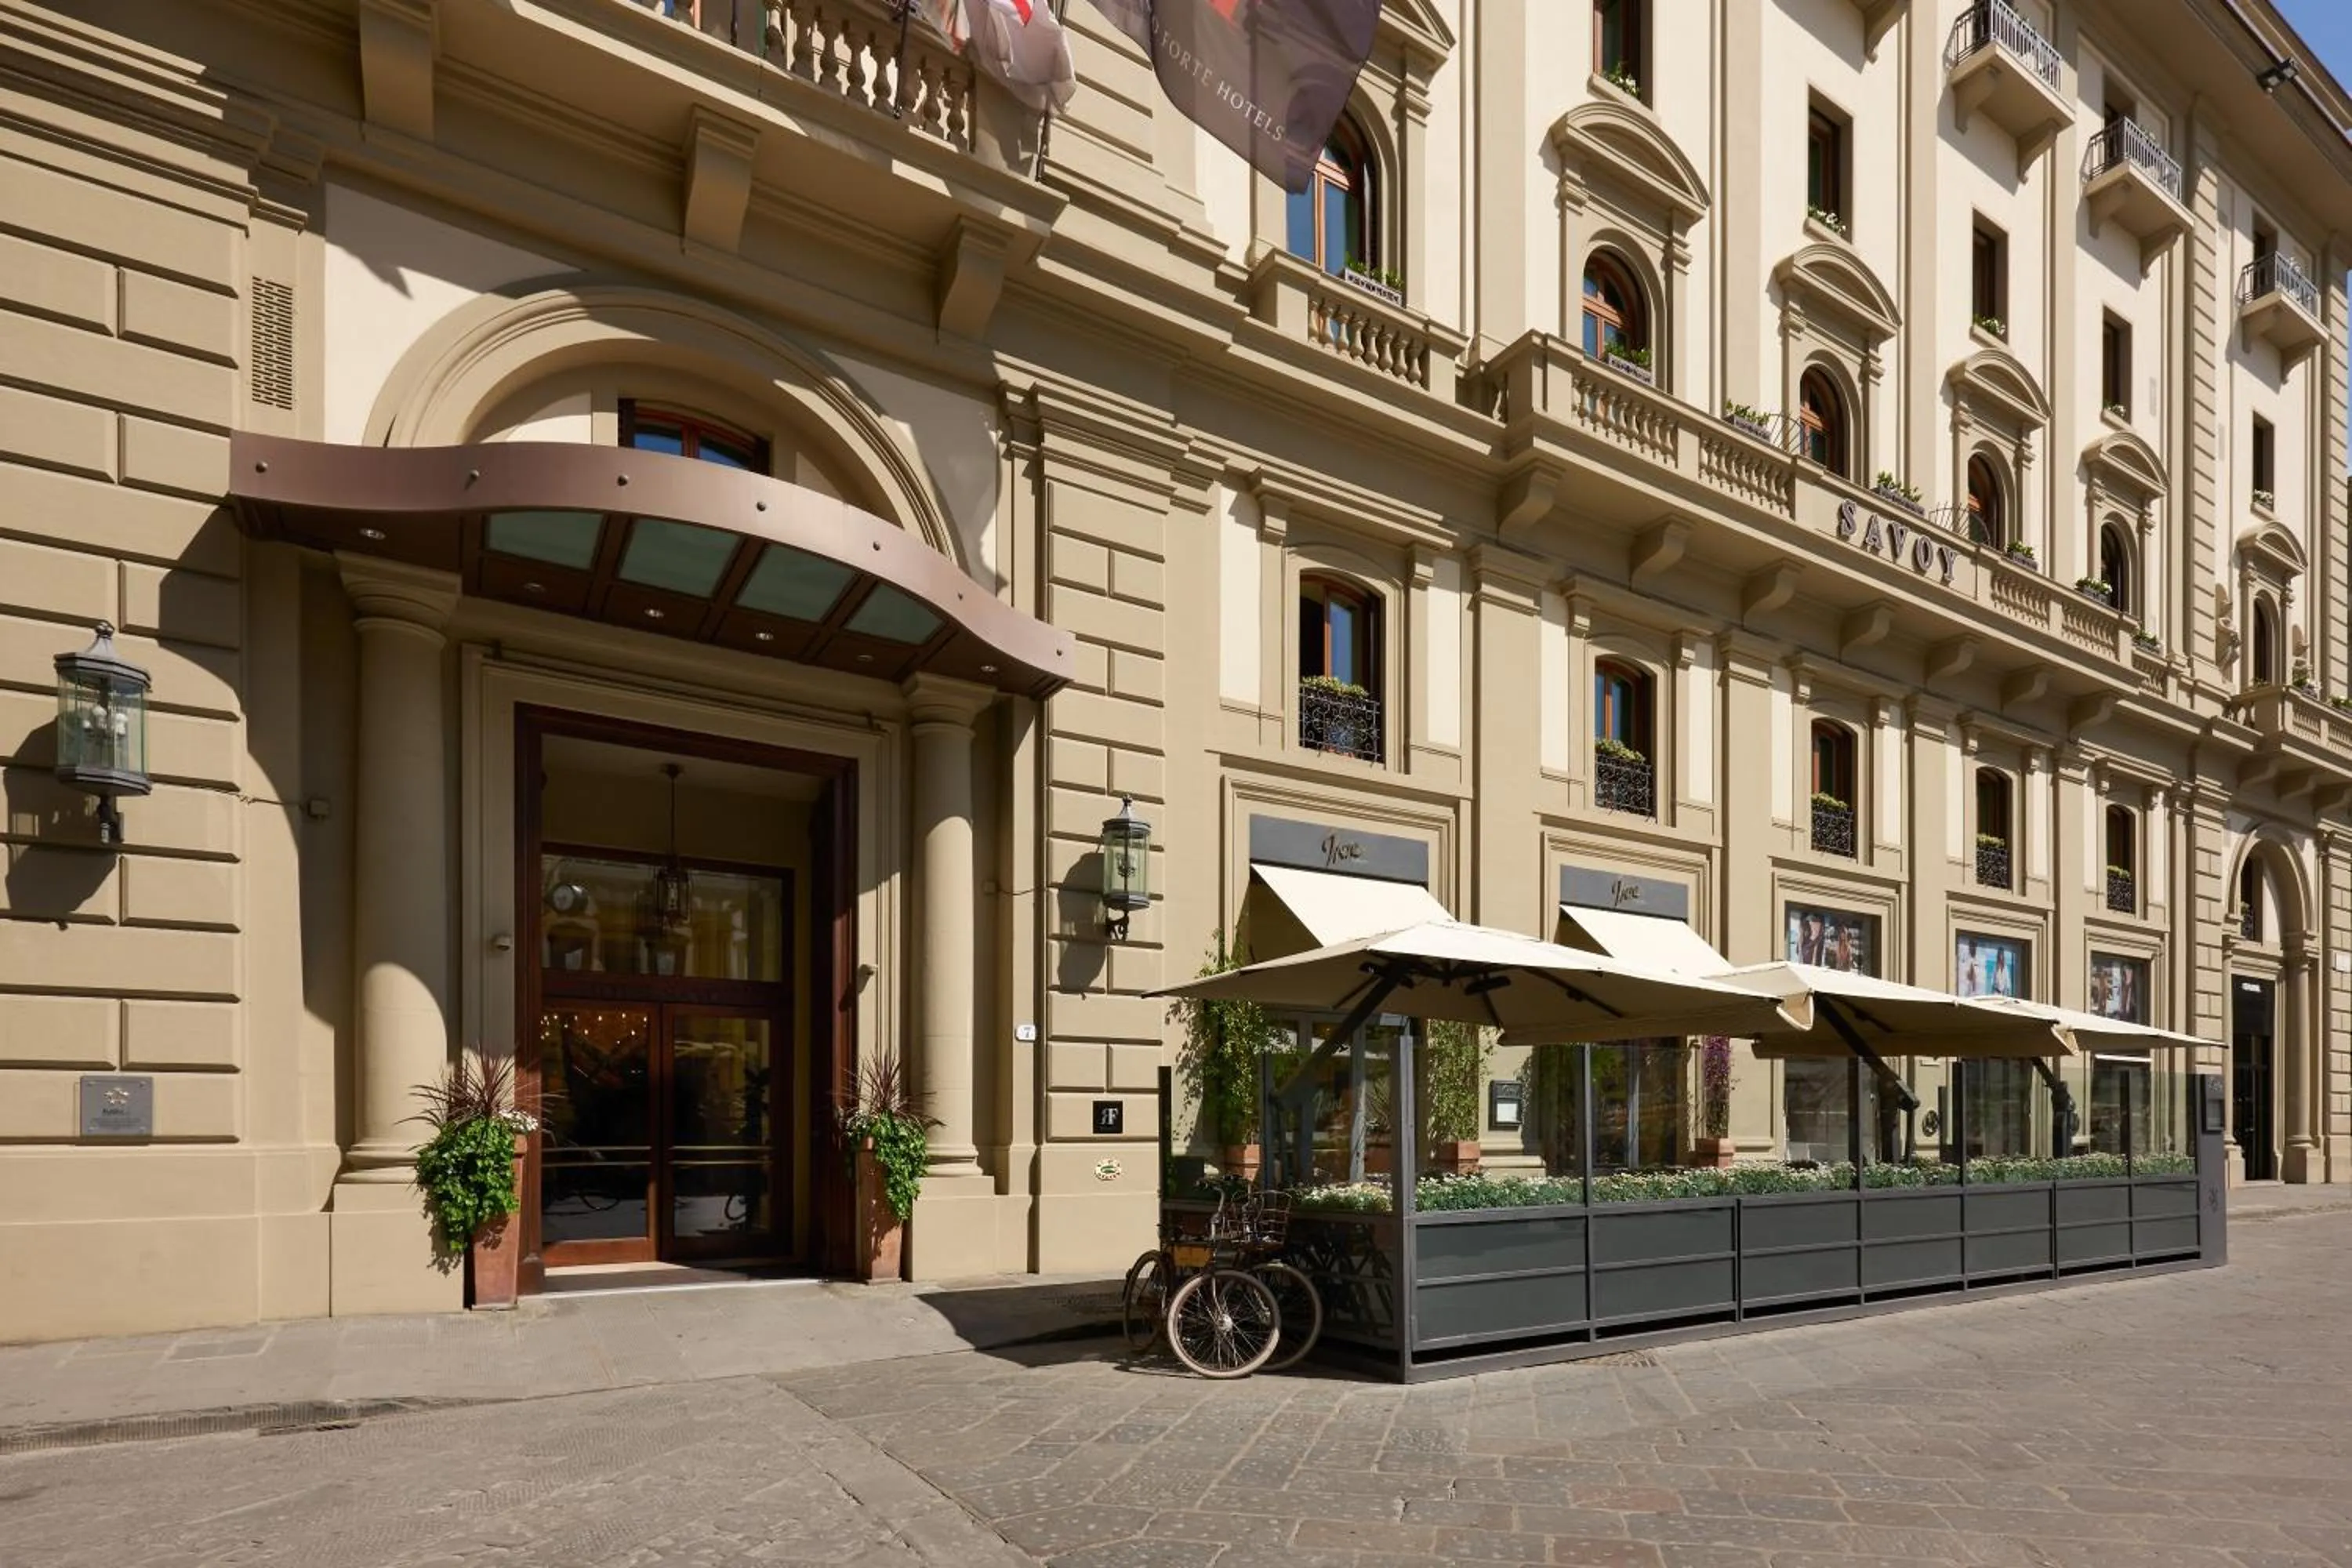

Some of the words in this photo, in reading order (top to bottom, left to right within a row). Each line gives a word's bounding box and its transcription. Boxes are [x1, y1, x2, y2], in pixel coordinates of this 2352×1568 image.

[1161, 31, 1212, 86] FORTE
[1217, 81, 1285, 140] HOTELS
[1838, 499, 1958, 582] SAVOY
